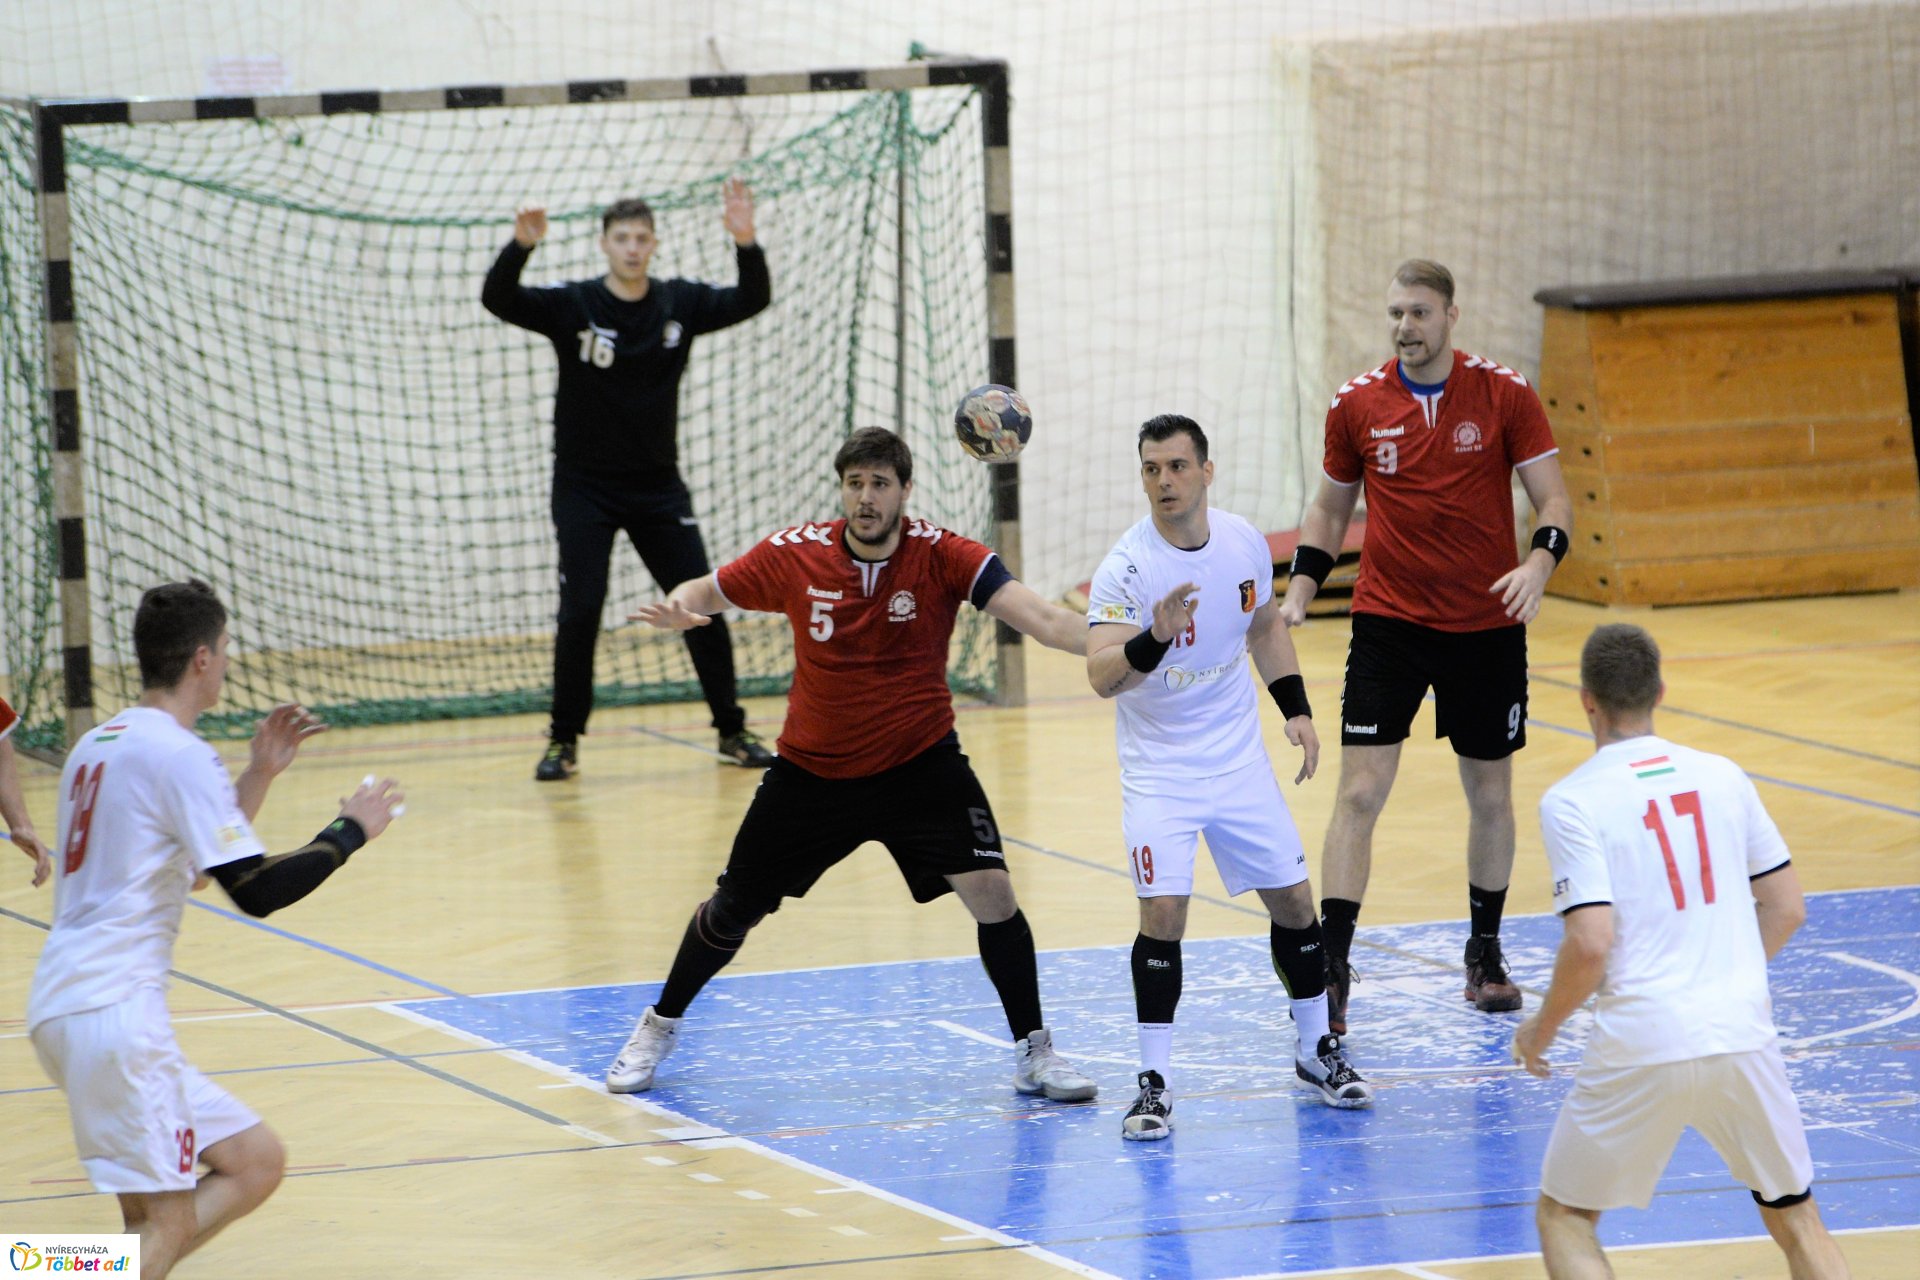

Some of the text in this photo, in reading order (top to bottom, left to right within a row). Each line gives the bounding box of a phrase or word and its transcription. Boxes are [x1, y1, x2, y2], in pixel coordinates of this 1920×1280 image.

[576, 328, 616, 369] 16
[1371, 424, 1405, 439] hummel
[1375, 441, 1398, 475] 9
[806, 584, 844, 600] hummel
[808, 601, 835, 643] 5
[1344, 722, 1378, 735] hummel
[1507, 702, 1521, 740] 9
[968, 807, 996, 844] 5
[1132, 845, 1155, 885] 19
[1642, 791, 1716, 911] 17
